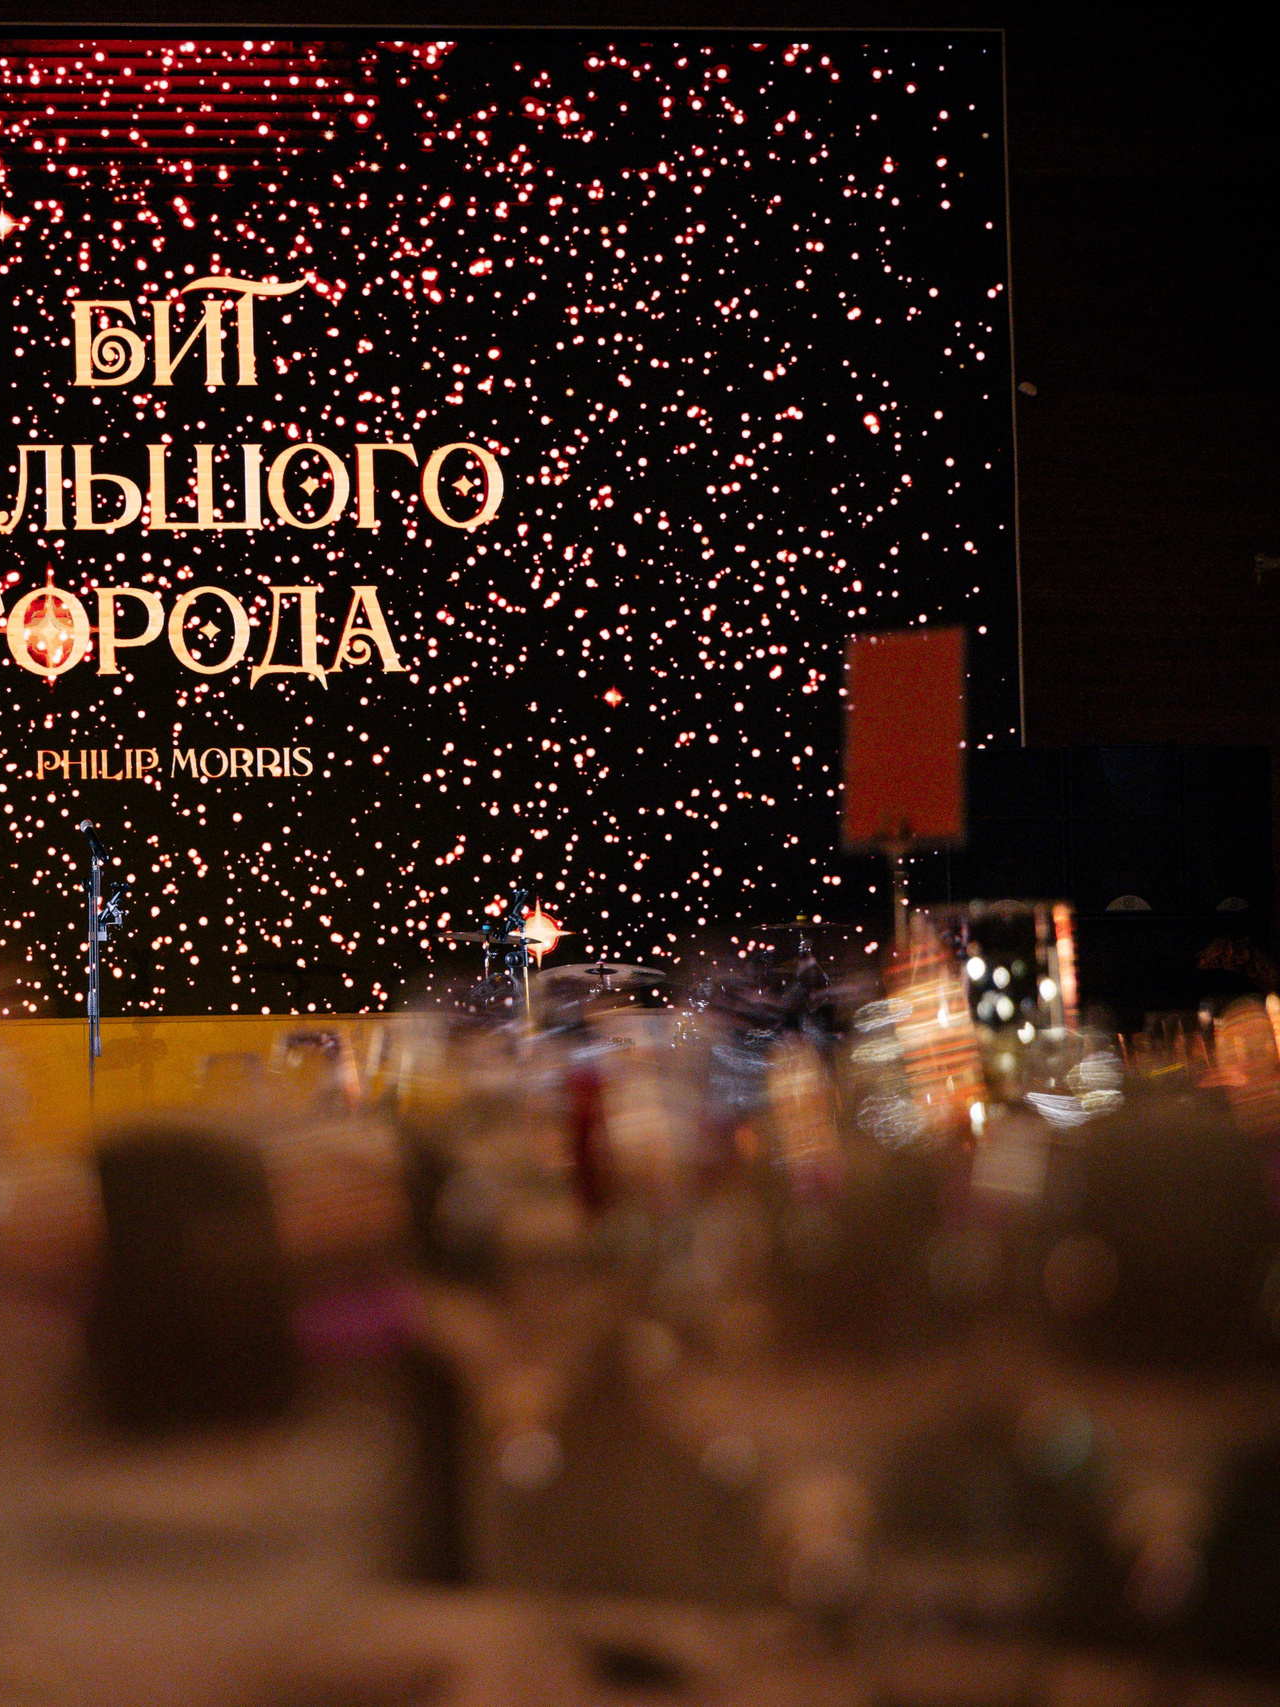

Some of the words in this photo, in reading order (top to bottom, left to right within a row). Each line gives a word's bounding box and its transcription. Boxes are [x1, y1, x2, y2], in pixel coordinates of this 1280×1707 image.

[72, 276, 310, 387] БИТ
[36, 749, 160, 780] PHILIP
[170, 746, 314, 778] MORRIS
